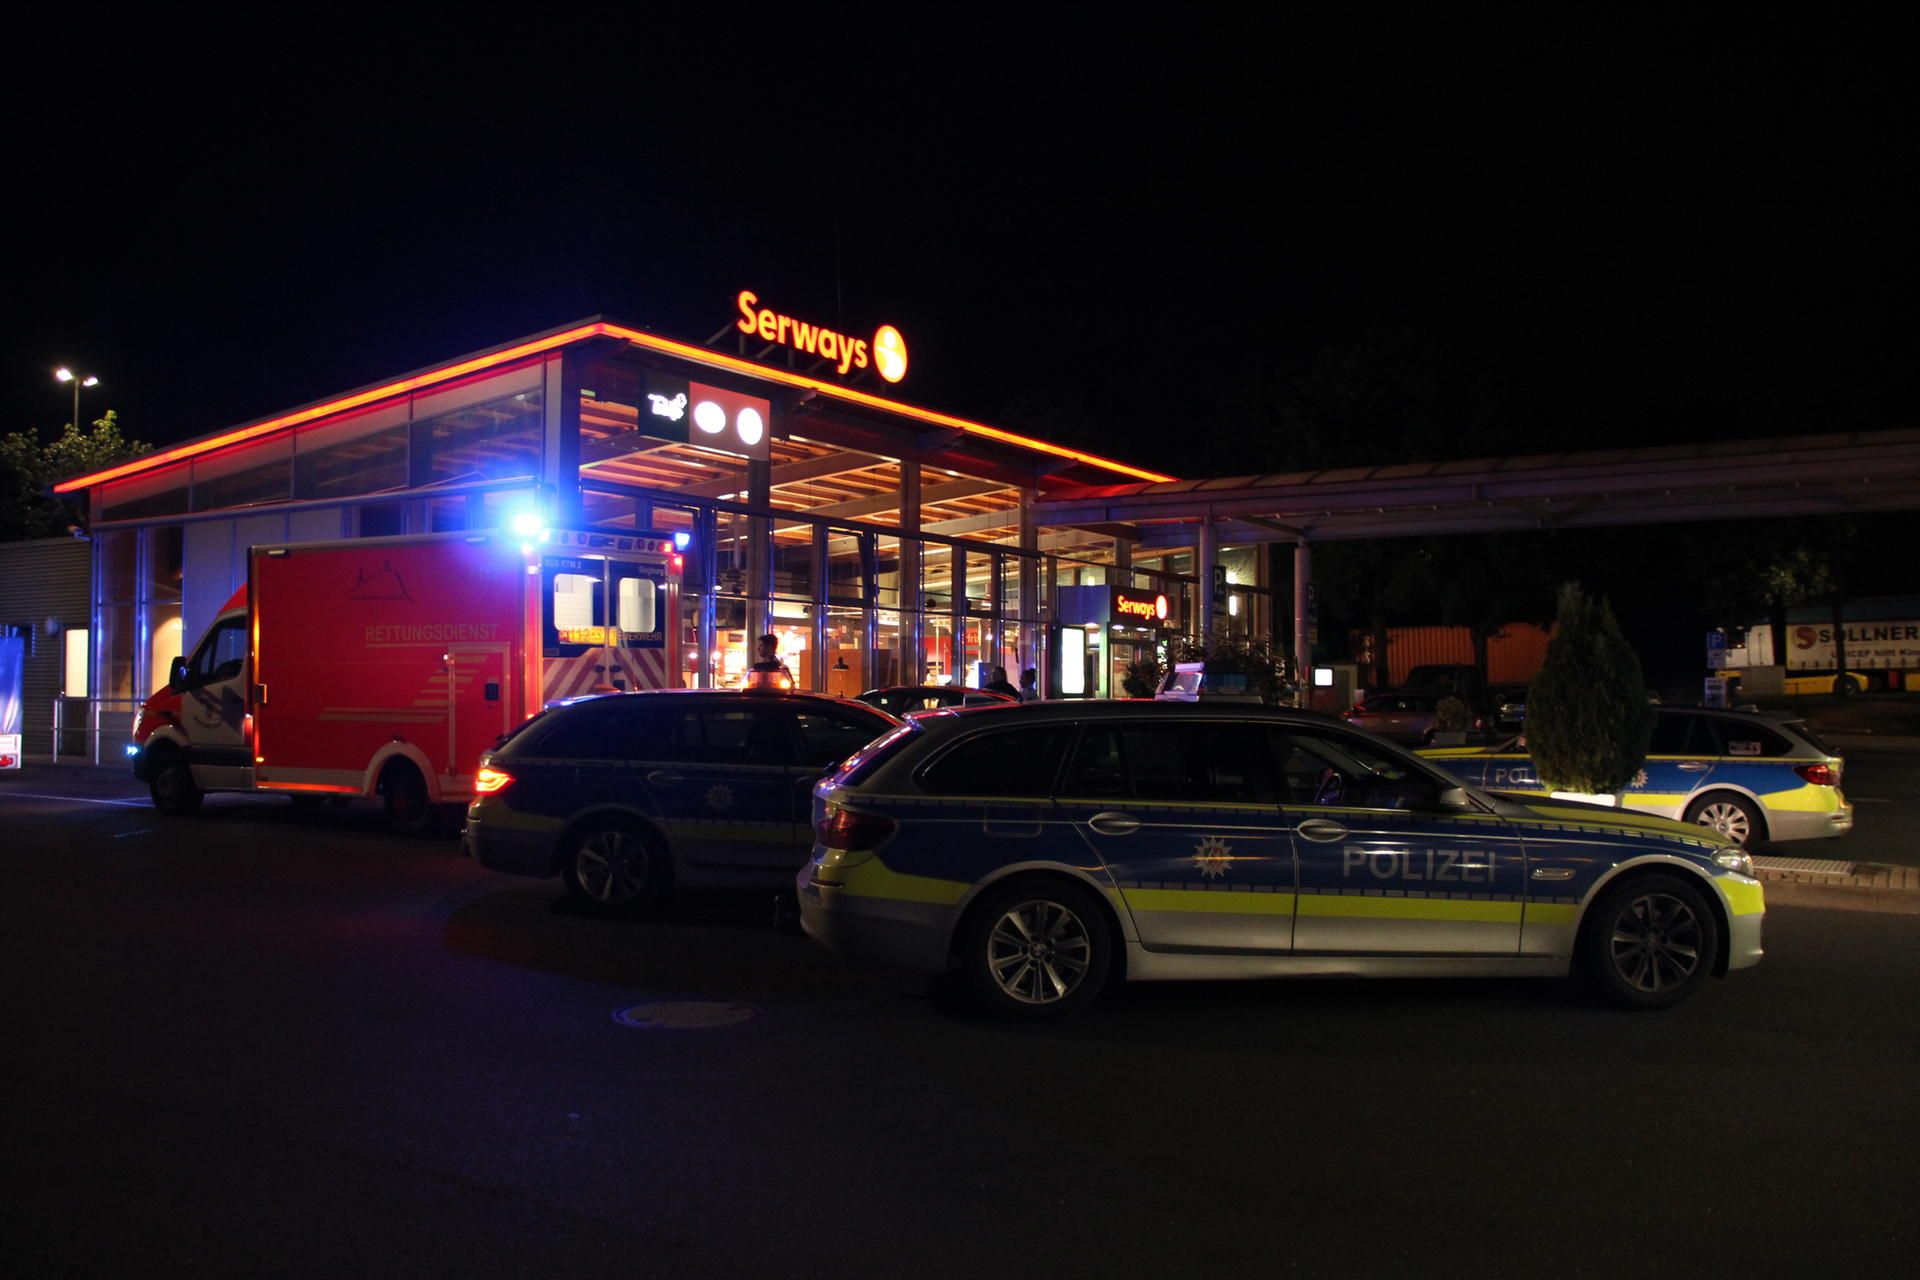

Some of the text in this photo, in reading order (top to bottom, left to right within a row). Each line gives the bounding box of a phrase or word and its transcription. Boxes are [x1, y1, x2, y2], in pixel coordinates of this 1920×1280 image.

[737, 291, 868, 375] Serways
[1117, 594, 1156, 620] Serways
[365, 623, 498, 641] RETTUNGSDIENST
[1711, 634, 1722, 647] P
[1819, 626, 1918, 643] SLLNER
[1342, 846, 1496, 882] POLIZEI
